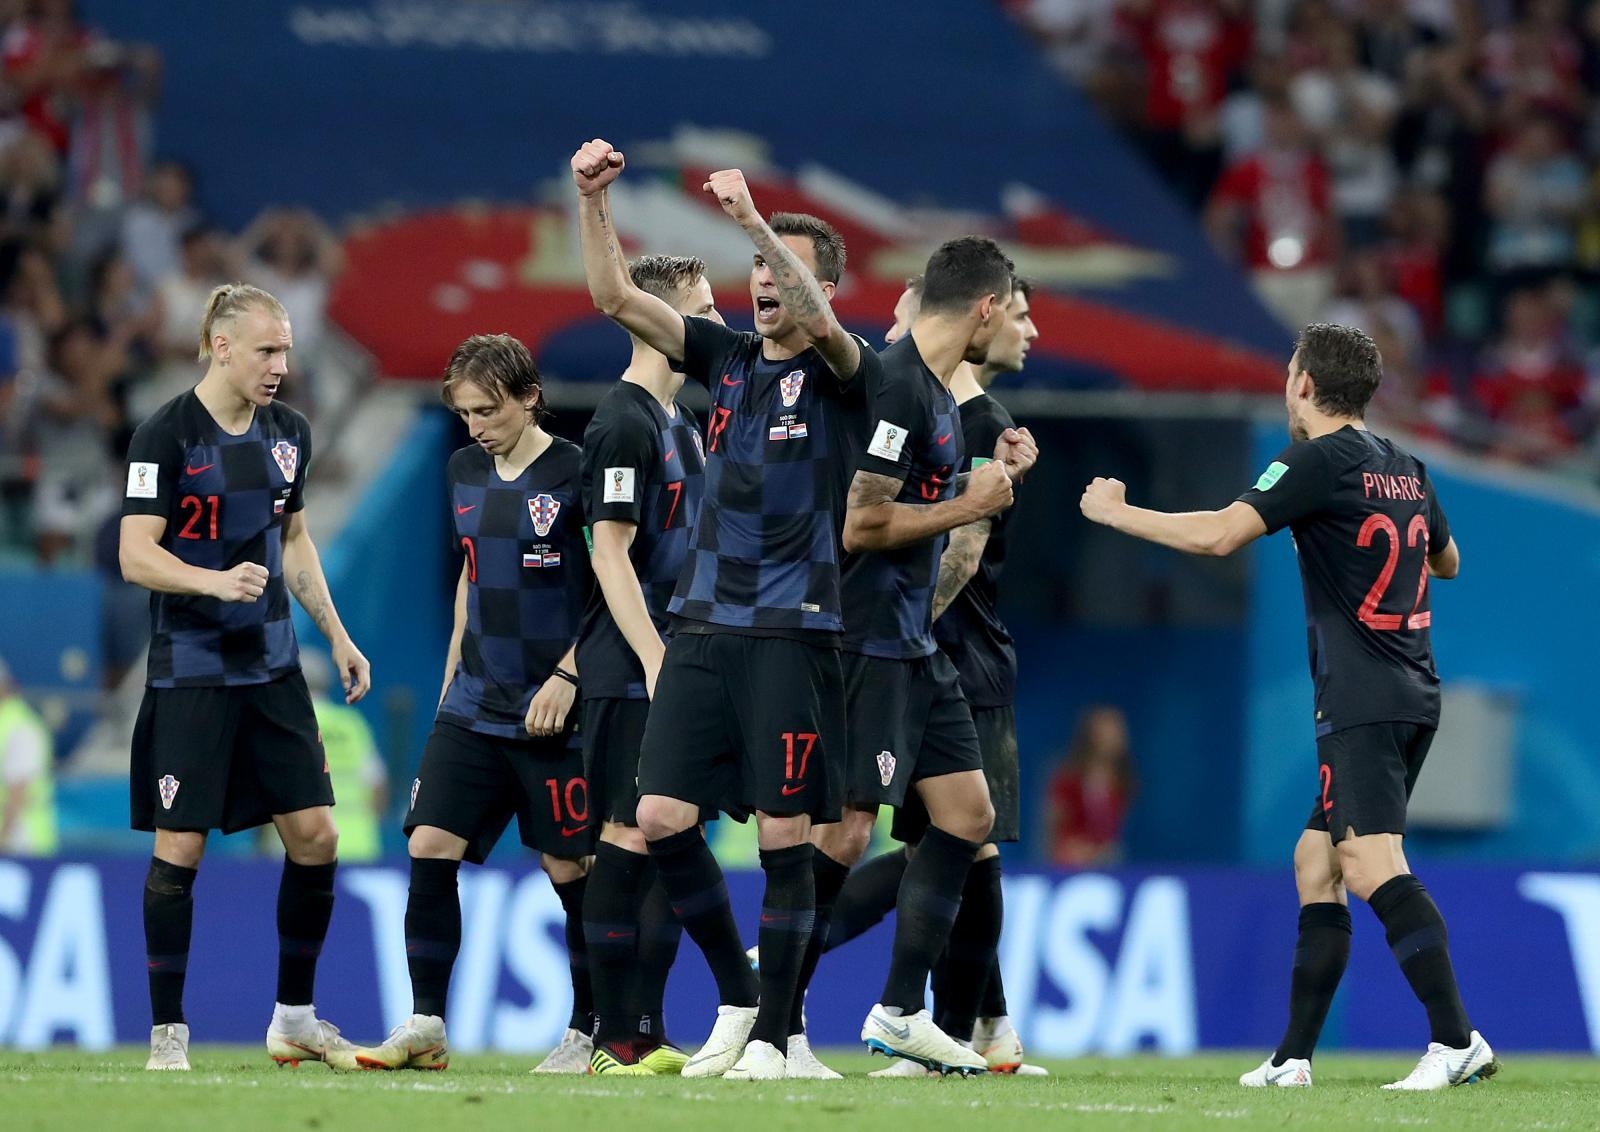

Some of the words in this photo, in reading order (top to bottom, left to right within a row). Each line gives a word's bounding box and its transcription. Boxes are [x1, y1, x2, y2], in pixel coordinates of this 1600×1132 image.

[178, 495, 219, 540] 21
[663, 480, 683, 529] 7
[1356, 513, 1432, 631] 22
[781, 731, 818, 780] 17
[545, 776, 588, 823] 10
[1000, 872, 1198, 1056] ISA
